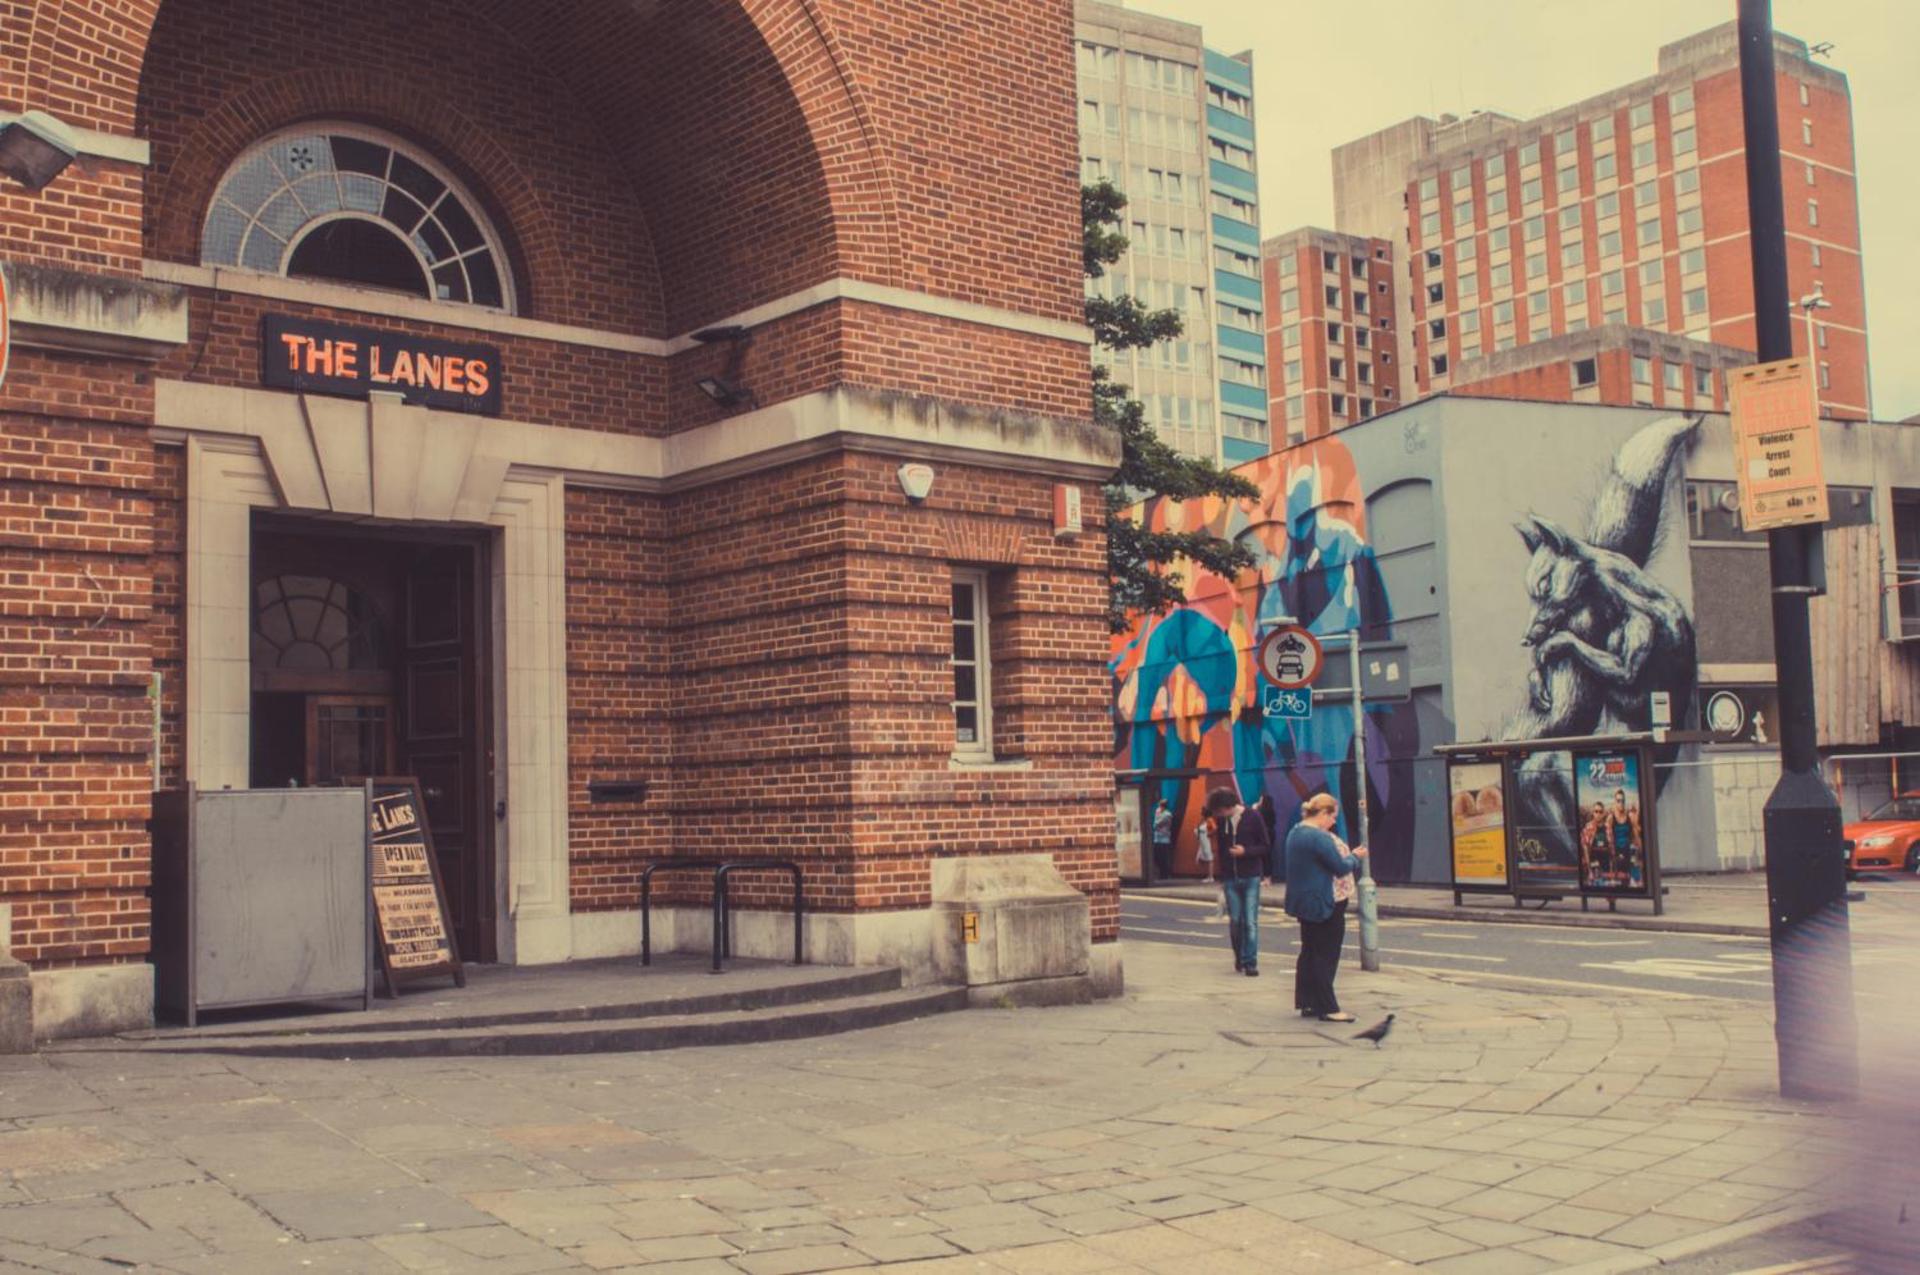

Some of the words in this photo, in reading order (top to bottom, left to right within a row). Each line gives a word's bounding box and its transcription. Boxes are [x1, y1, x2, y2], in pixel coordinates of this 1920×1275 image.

[281, 333, 358, 379] THE
[370, 345, 490, 396] LANES
[1758, 432, 1794, 446] Violence
[1766, 450, 1791, 461] Arrest
[1768, 466, 1791, 478] Court
[1590, 762, 1606, 780] 22
[380, 803, 415, 830] LANES
